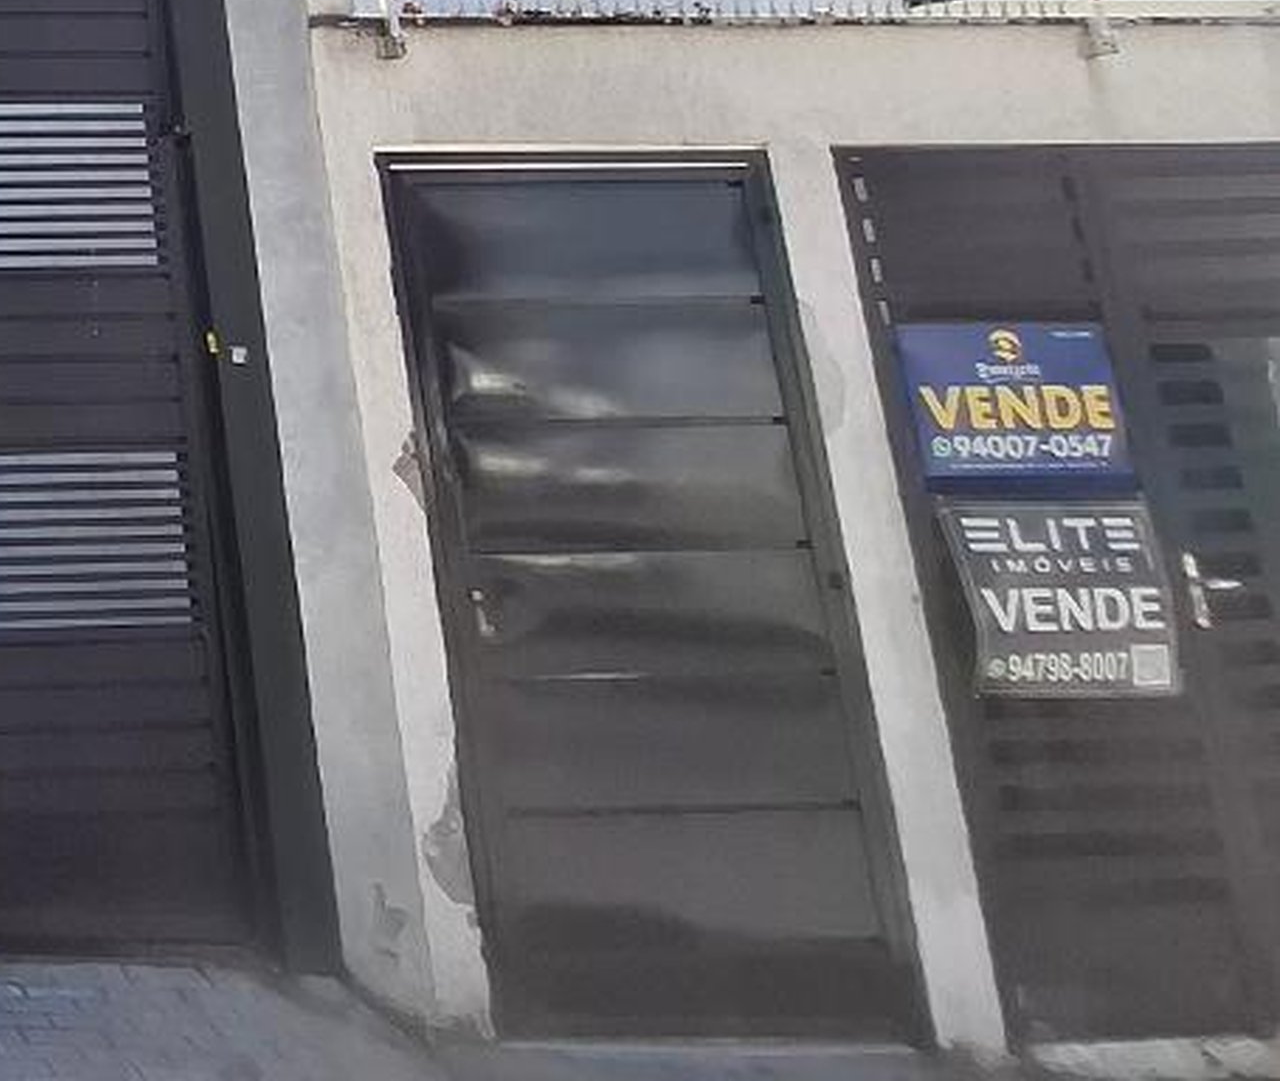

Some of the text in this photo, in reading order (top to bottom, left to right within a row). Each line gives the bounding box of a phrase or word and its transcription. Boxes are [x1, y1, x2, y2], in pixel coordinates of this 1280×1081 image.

[919, 384, 1116, 430] VENDE
[953, 434, 1112, 458] 94007-0547
[961, 518, 1141, 552] ELITE
[981, 587, 1166, 632] VENDE
[1008, 652, 1129, 681] 94798-8007
